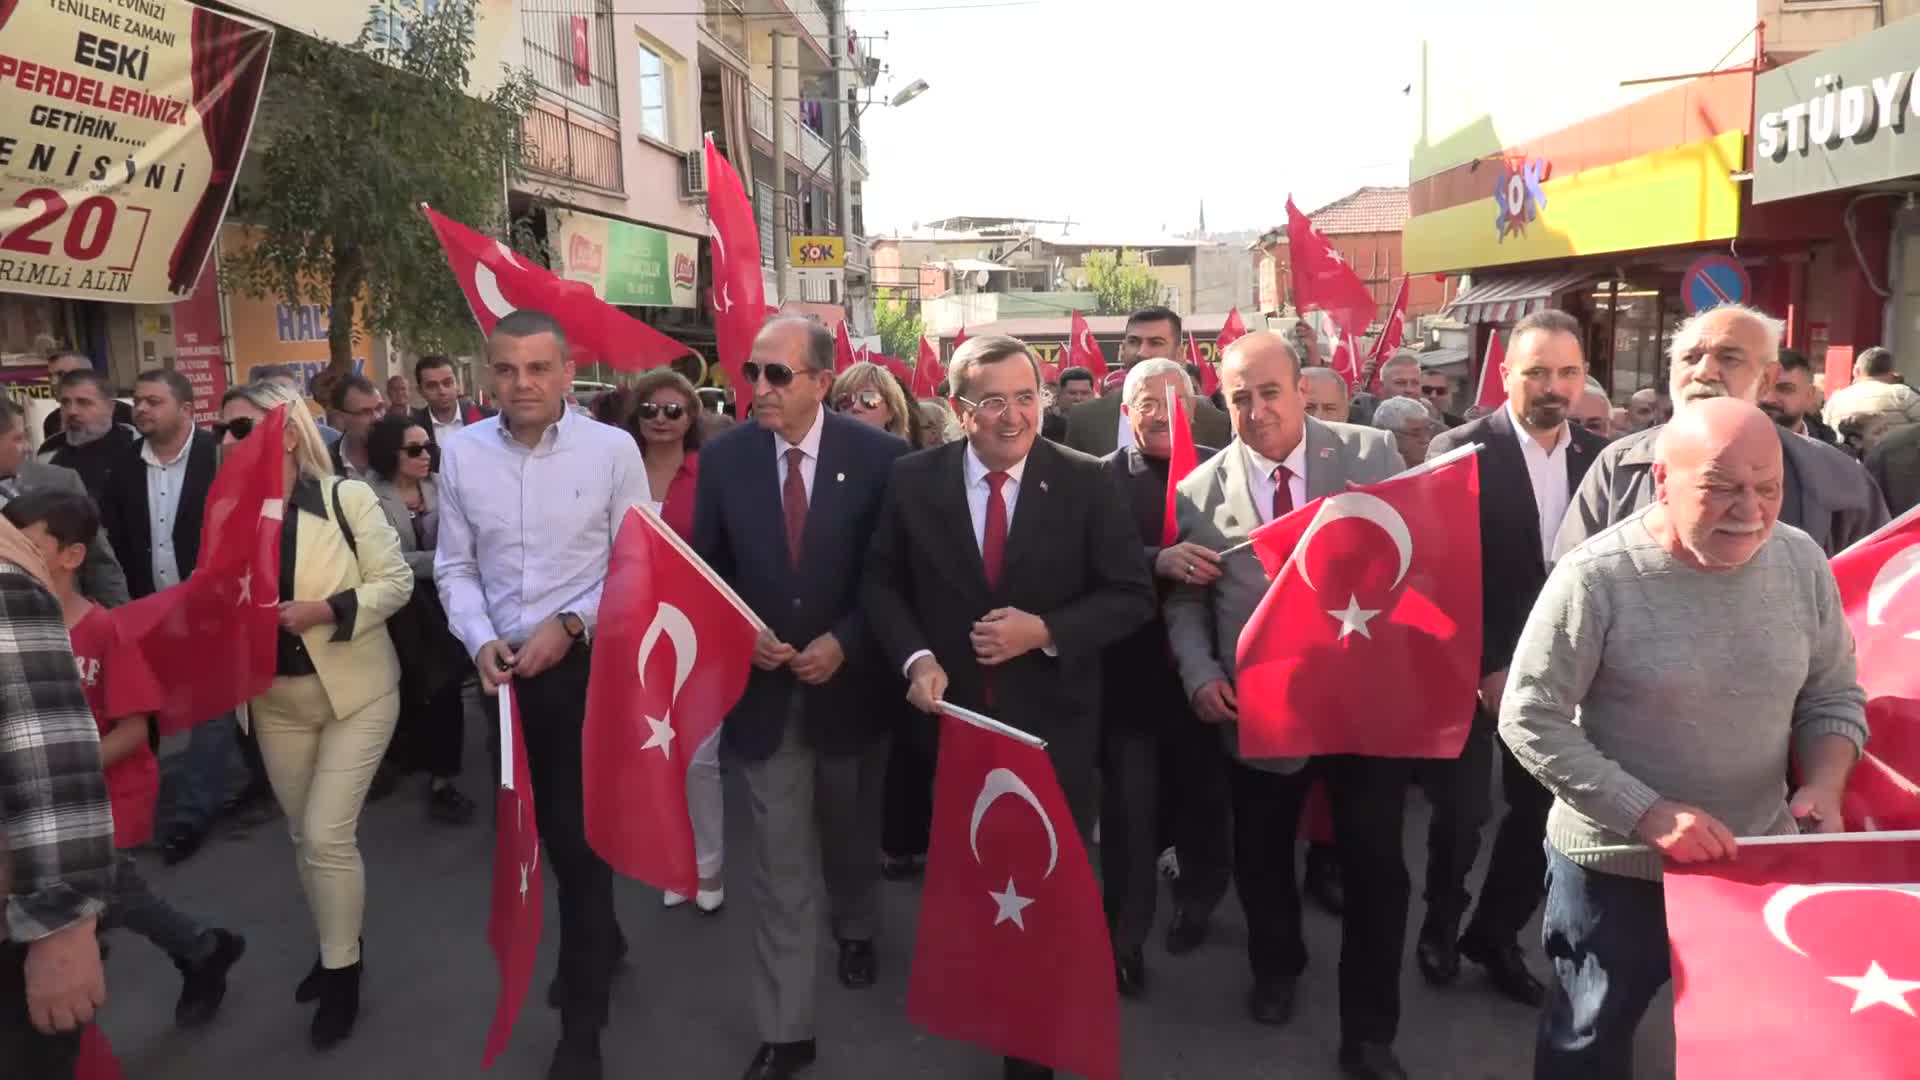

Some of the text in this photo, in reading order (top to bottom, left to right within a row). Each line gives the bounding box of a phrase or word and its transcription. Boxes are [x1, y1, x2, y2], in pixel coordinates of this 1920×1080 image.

[124, 18, 175, 47] ZAMANI
[74, 31, 149, 81] ESKİ
[1495, 155, 1549, 246] ŞOK
[799, 242, 835, 265] ŞOK
[77, 269, 133, 293] ALIN
